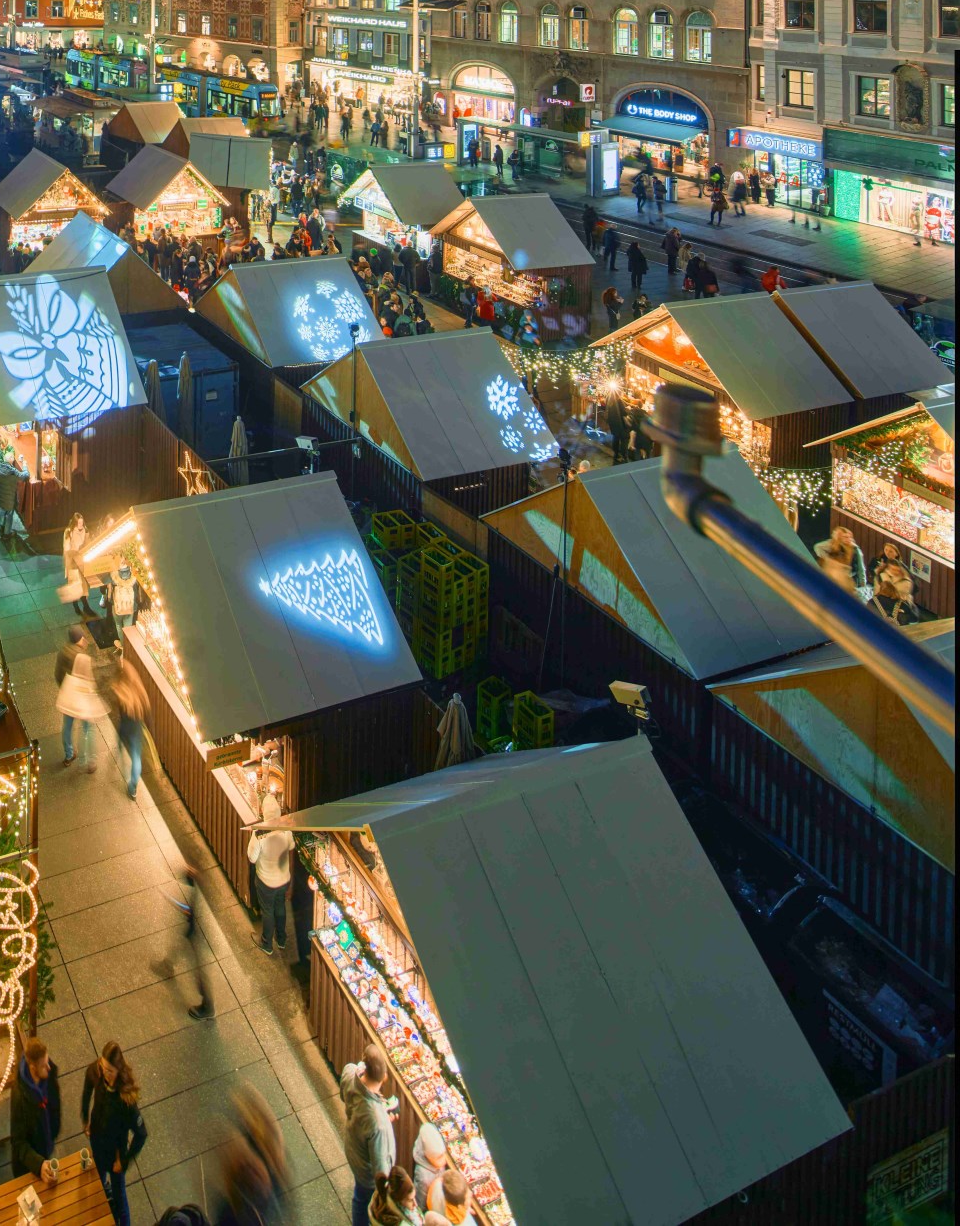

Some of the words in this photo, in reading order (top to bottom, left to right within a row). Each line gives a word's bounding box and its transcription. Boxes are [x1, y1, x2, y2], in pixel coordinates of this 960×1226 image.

[327, 15, 377, 26] WEIKHARD
[378, 20, 407, 28] HAUS
[311, 57, 348, 66] JUWELIER
[336, 70, 387, 83] WEIKHARD
[371, 65, 425, 76] UHRENHAS
[639, 107, 653, 117] THE
[654, 109, 674, 119] BODY
[675, 112, 697, 122] SHOP
[746, 135, 816, 157] APOTHEKE
